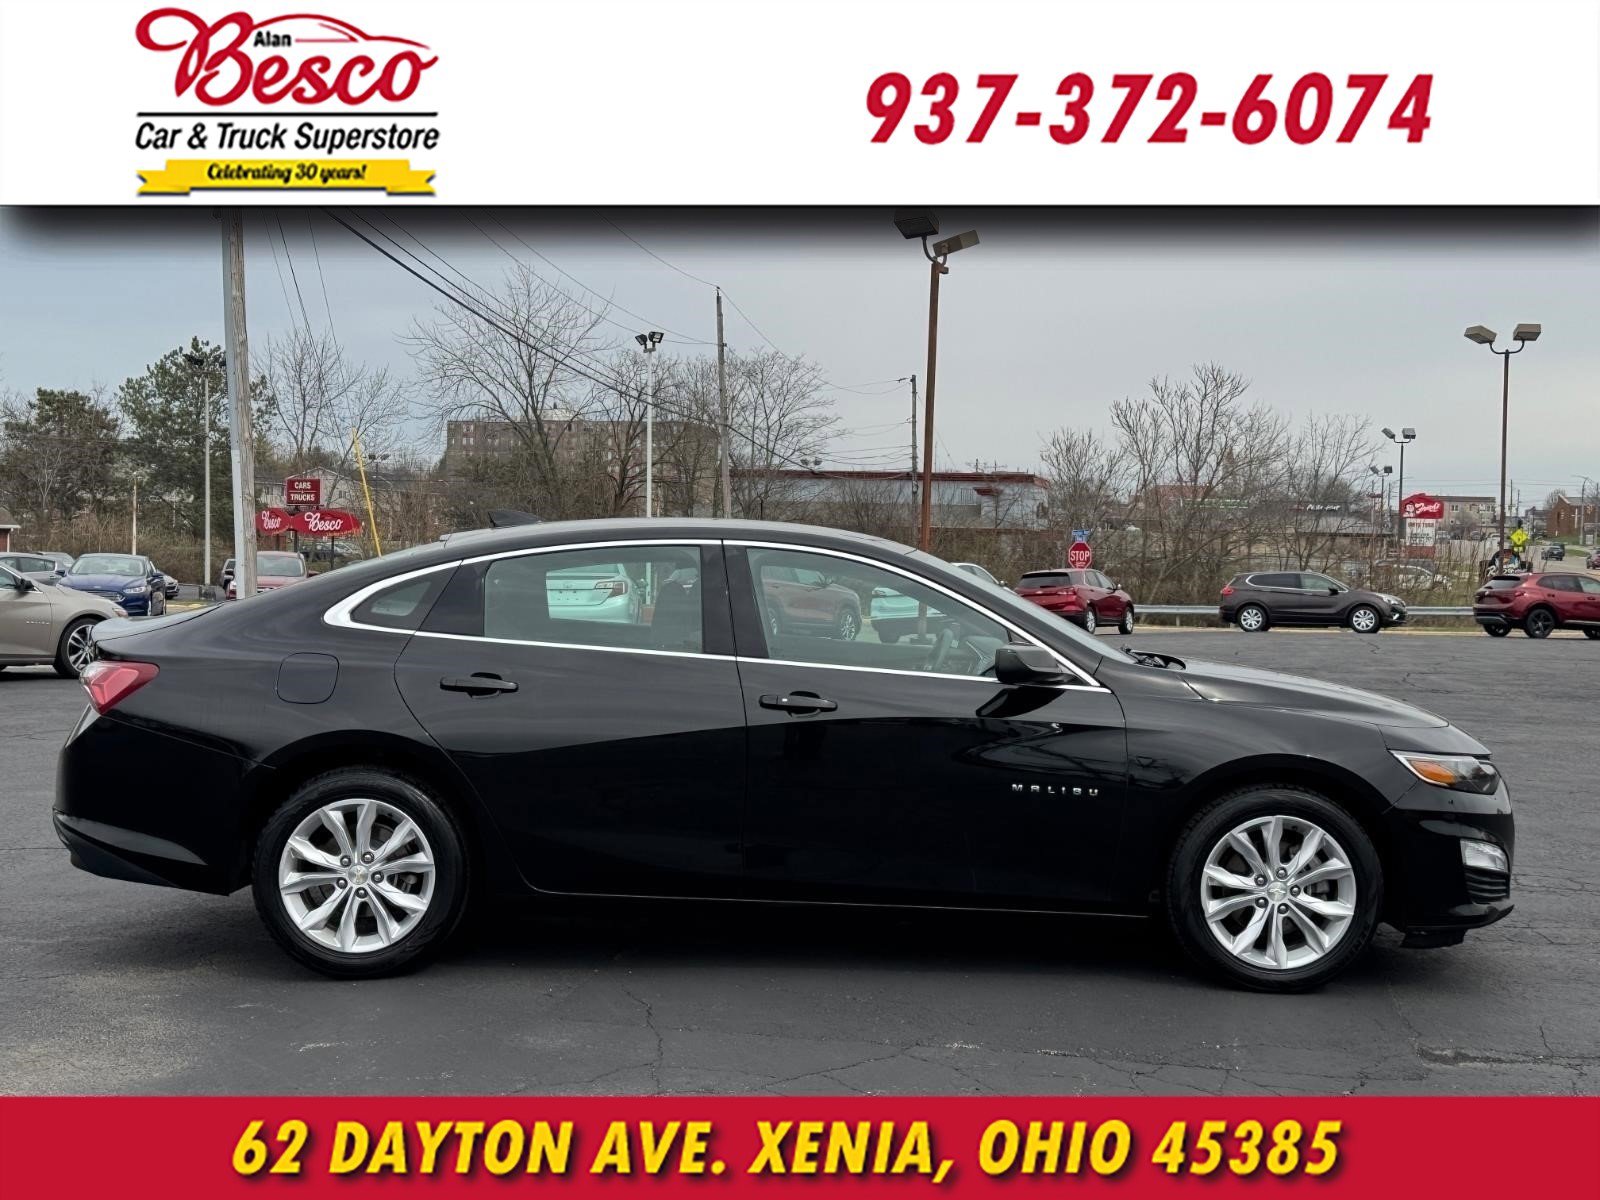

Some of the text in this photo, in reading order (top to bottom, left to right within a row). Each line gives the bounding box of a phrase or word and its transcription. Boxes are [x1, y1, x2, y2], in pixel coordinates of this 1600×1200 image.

[294, 481, 312, 489] CARS
[290, 493, 316, 502] TRUCKS
[304, 512, 343, 531] Besco
[1070, 550, 1090, 561] STOP
[1011, 783, 1099, 797] MALIBU
